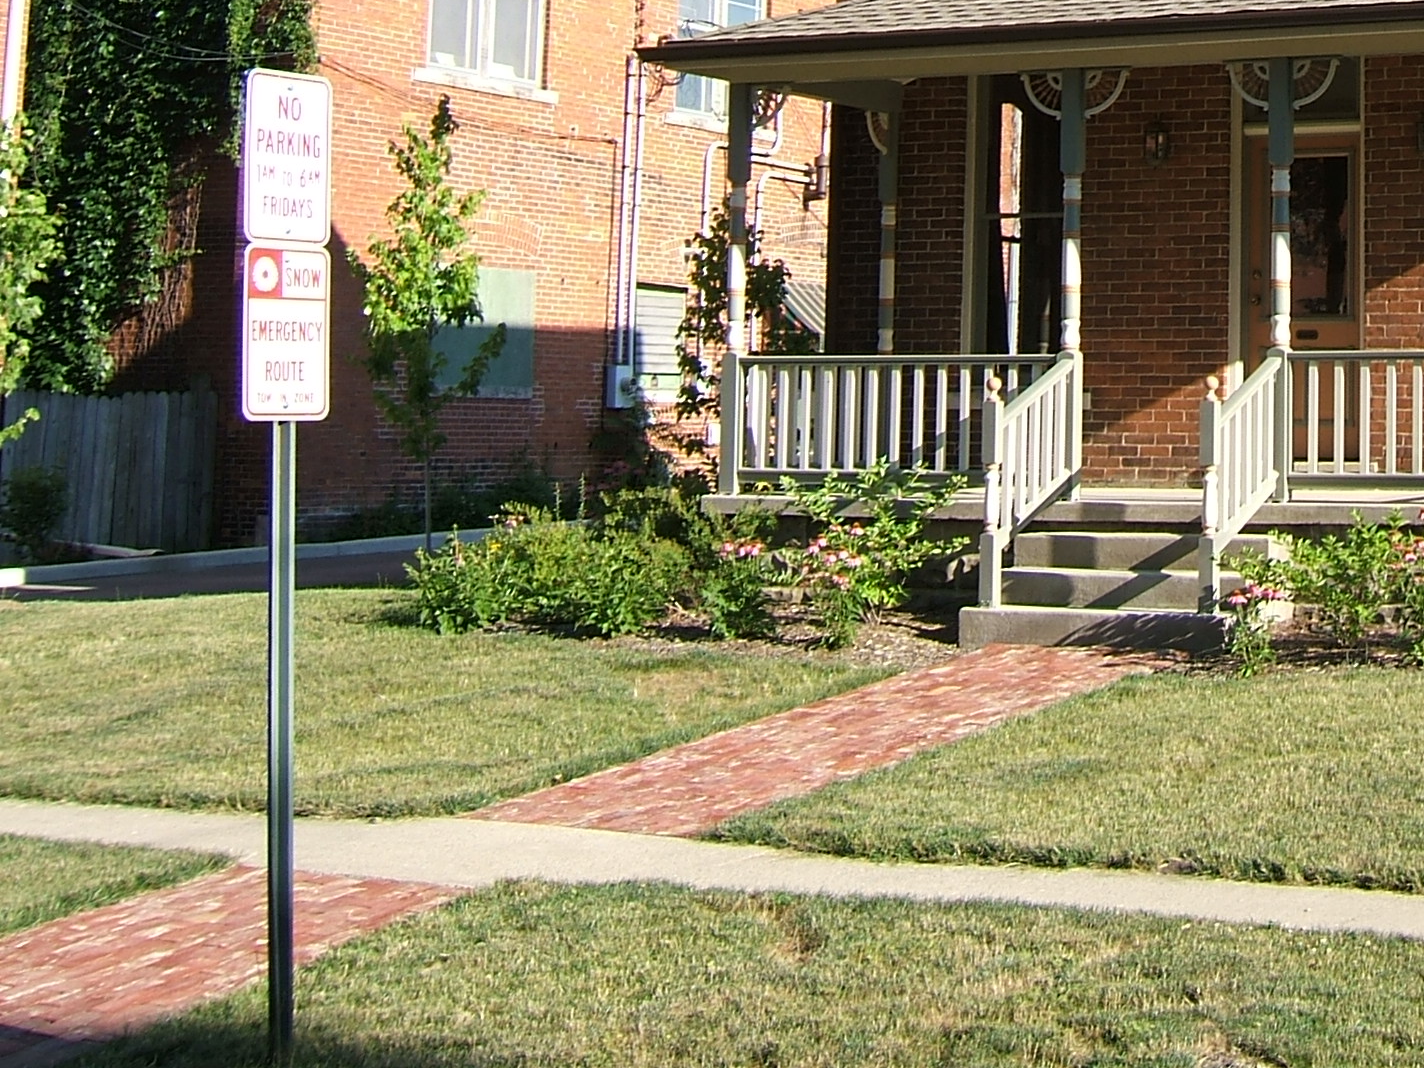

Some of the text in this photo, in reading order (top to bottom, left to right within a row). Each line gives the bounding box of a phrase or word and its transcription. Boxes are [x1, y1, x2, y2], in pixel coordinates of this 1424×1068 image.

[278, 95, 302, 121] NO
[257, 129, 321, 159] PARKING
[282, 171, 293, 187] TO
[263, 195, 313, 219] FRIDAYS
[285, 267, 321, 289] SNOW
[252, 320, 322, 343] EMERGENCY
[265, 361, 305, 382] ROUTE
